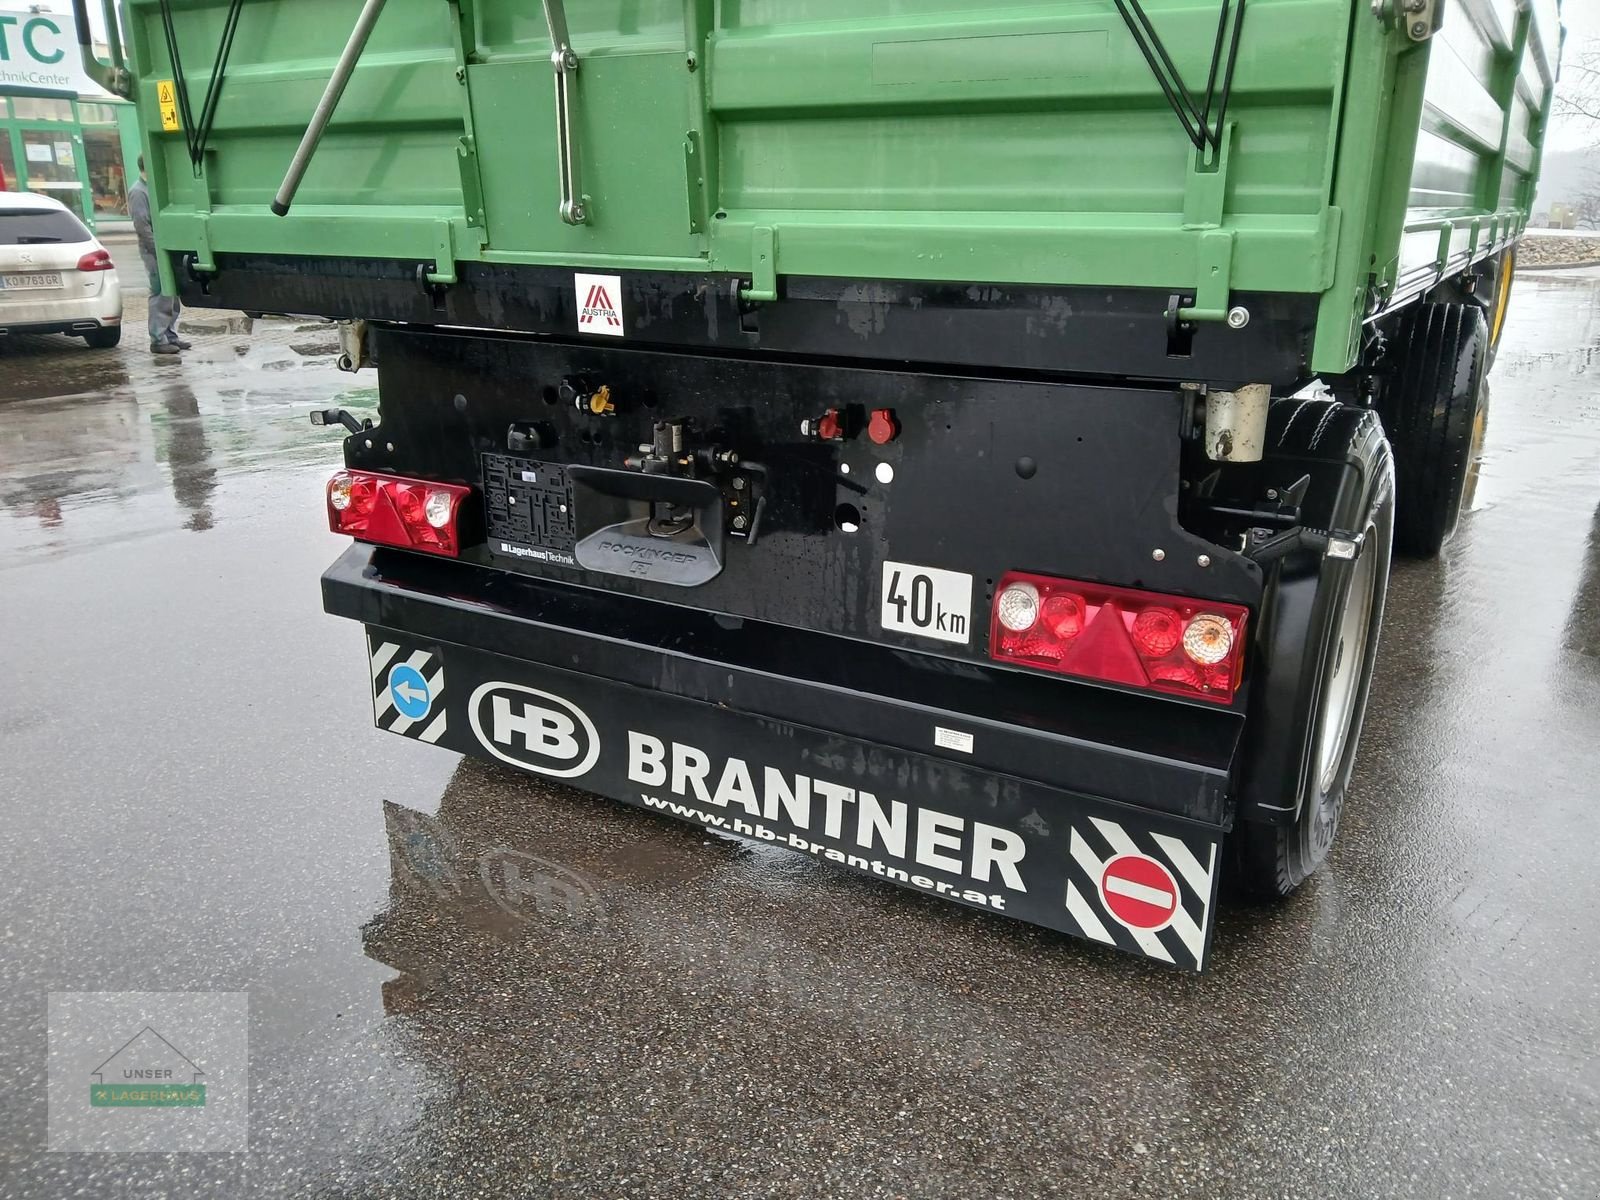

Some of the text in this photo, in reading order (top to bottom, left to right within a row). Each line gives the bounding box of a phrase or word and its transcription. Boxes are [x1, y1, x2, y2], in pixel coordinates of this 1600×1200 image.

[25, 275, 45, 285] 763
[45, 275, 59, 285] GR
[582, 307, 617, 318] AUSTRIA
[599, 541, 697, 563] ROCKINGER
[887, 570, 966, 635] 40 km
[492, 694, 579, 760] HB
[627, 730, 1028, 893] BRANTNER
[641, 793, 1006, 911] www.hb-brantner.at
